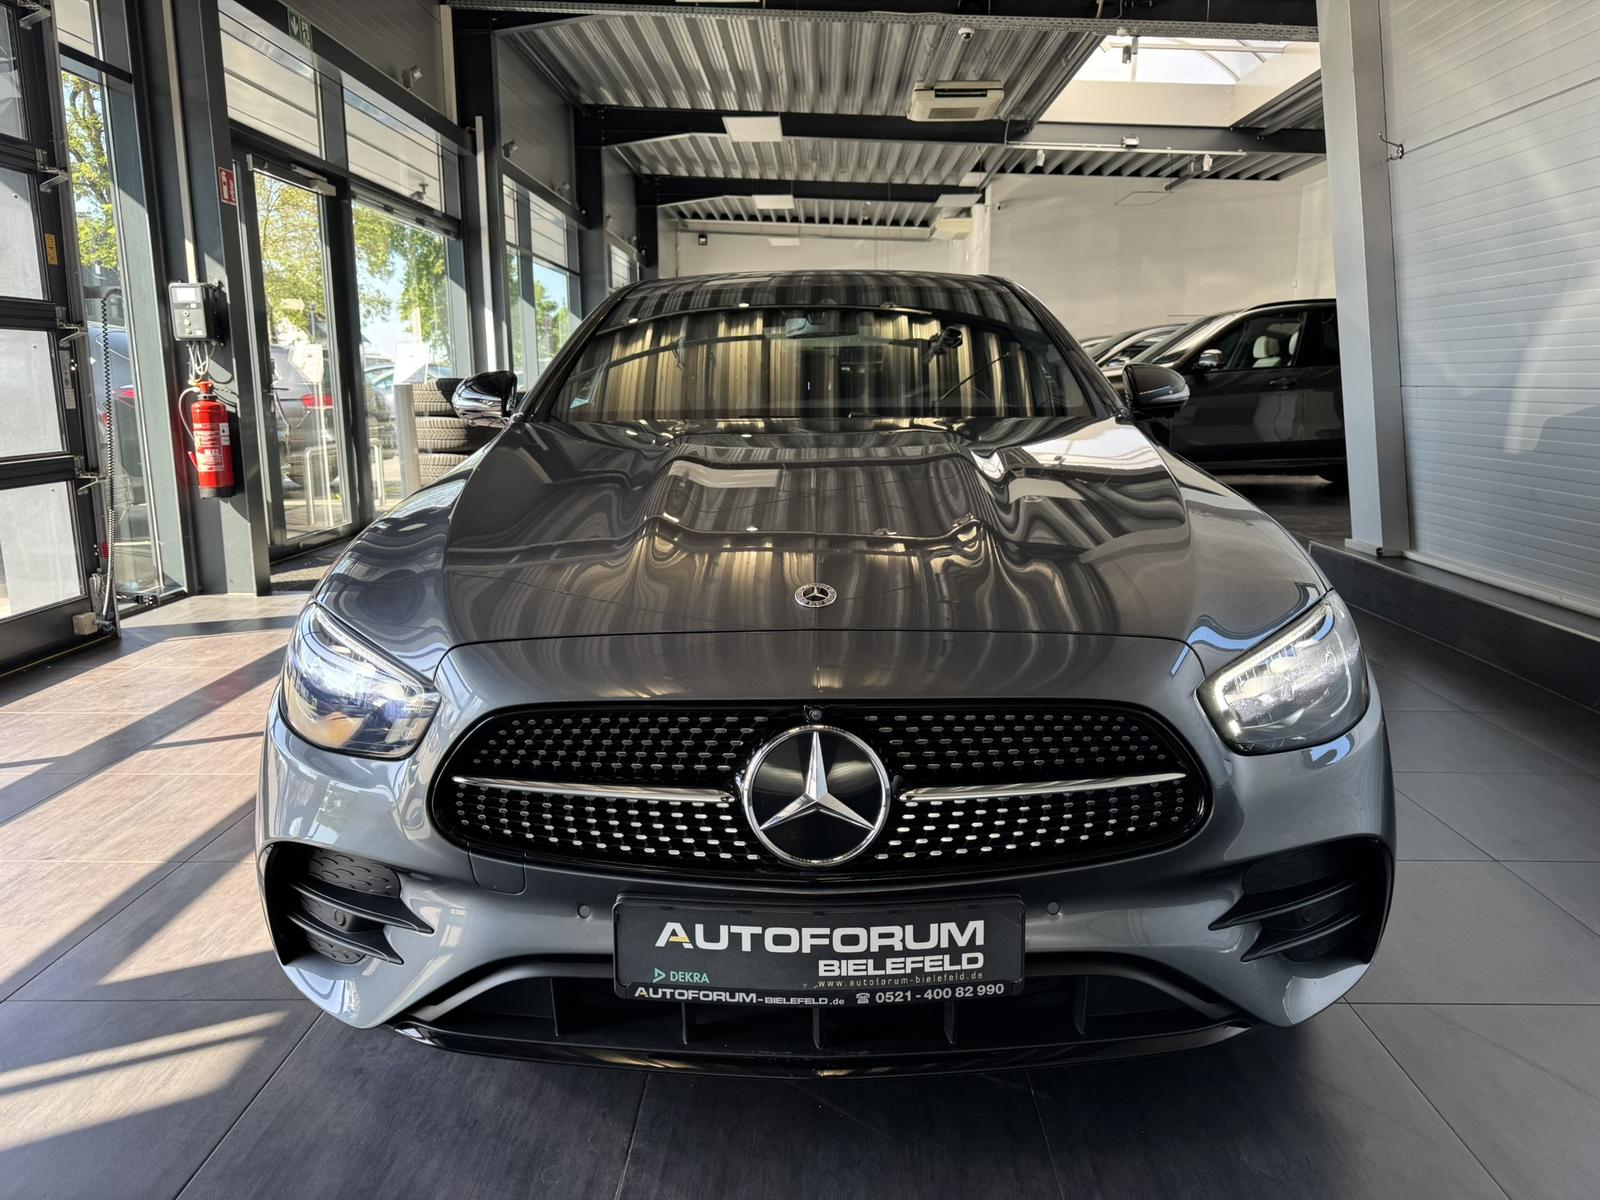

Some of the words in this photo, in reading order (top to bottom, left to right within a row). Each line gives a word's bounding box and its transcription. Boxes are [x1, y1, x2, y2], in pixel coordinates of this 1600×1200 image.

[654, 919, 985, 954] AUTOFORUM
[818, 952, 985, 977] BIELEFELD
[669, 970, 710, 984] DEKRA
[818, 971, 984, 988] www.autoforum-bielefeld.de
[923, 988, 951, 1001] 400
[955, 985, 974, 998] 82
[977, 983, 1005, 996] 990
